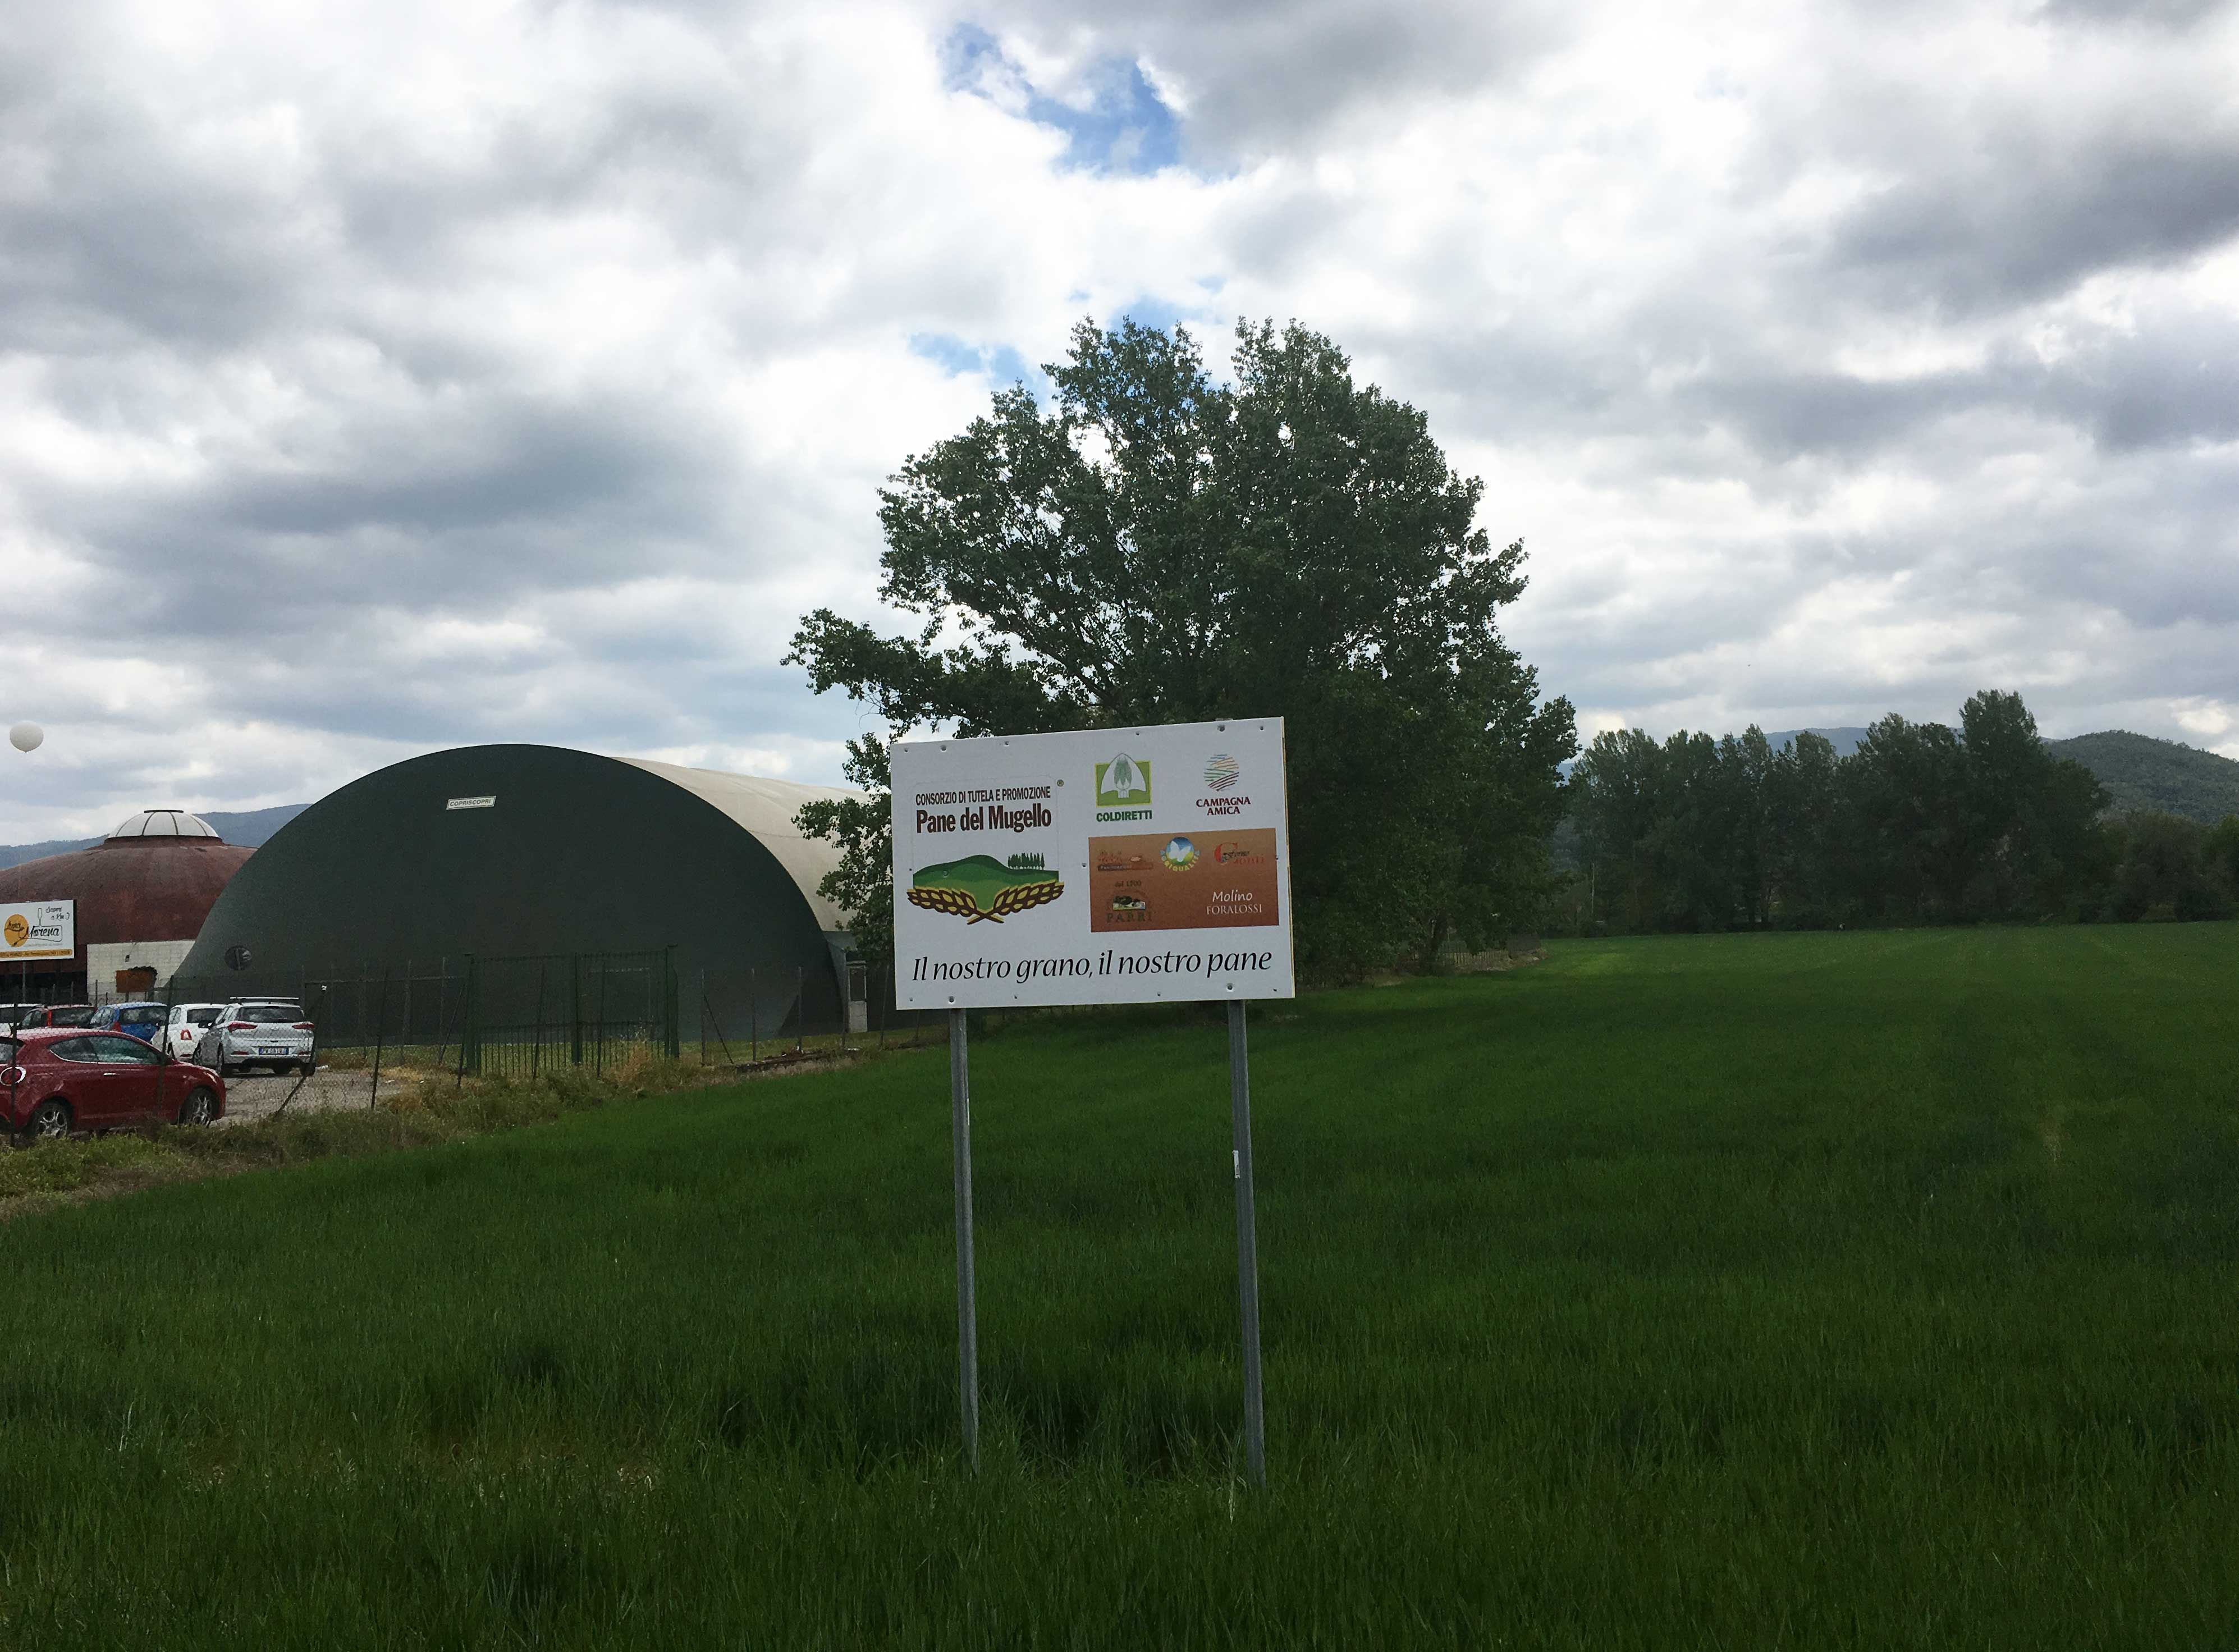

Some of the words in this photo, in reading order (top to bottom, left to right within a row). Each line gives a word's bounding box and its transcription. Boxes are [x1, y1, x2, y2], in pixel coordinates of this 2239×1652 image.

[915, 791, 957, 806] CONSORZIO
[959, 791, 966, 803] DI
[968, 789, 994, 803] TUTELA
[996, 789, 1001, 801] E
[1002, 786, 1051, 801] PROMOZIONE
[450, 798, 491, 807] COPRISCOPRI
[1196, 797, 1251, 808] CAMPAGNA
[1096, 810, 1152, 822] COLDIRETTI
[1207, 806, 1240, 816] AMICA
[916, 809, 956, 834] Pane
[960, 806, 984, 832] del
[988, 803, 1052, 833] Mugello
[1212, 889, 1253, 903] Molino
[1207, 904, 1262, 915] FORALOSSI
[912, 957, 928, 981] Il
[933, 957, 1010, 980] nostro
[1017, 958, 1092, 983] grano,
[1098, 950, 1112, 975] il
[1118, 951, 1201, 974] nostro
[1207, 951, 1272, 978] pane
